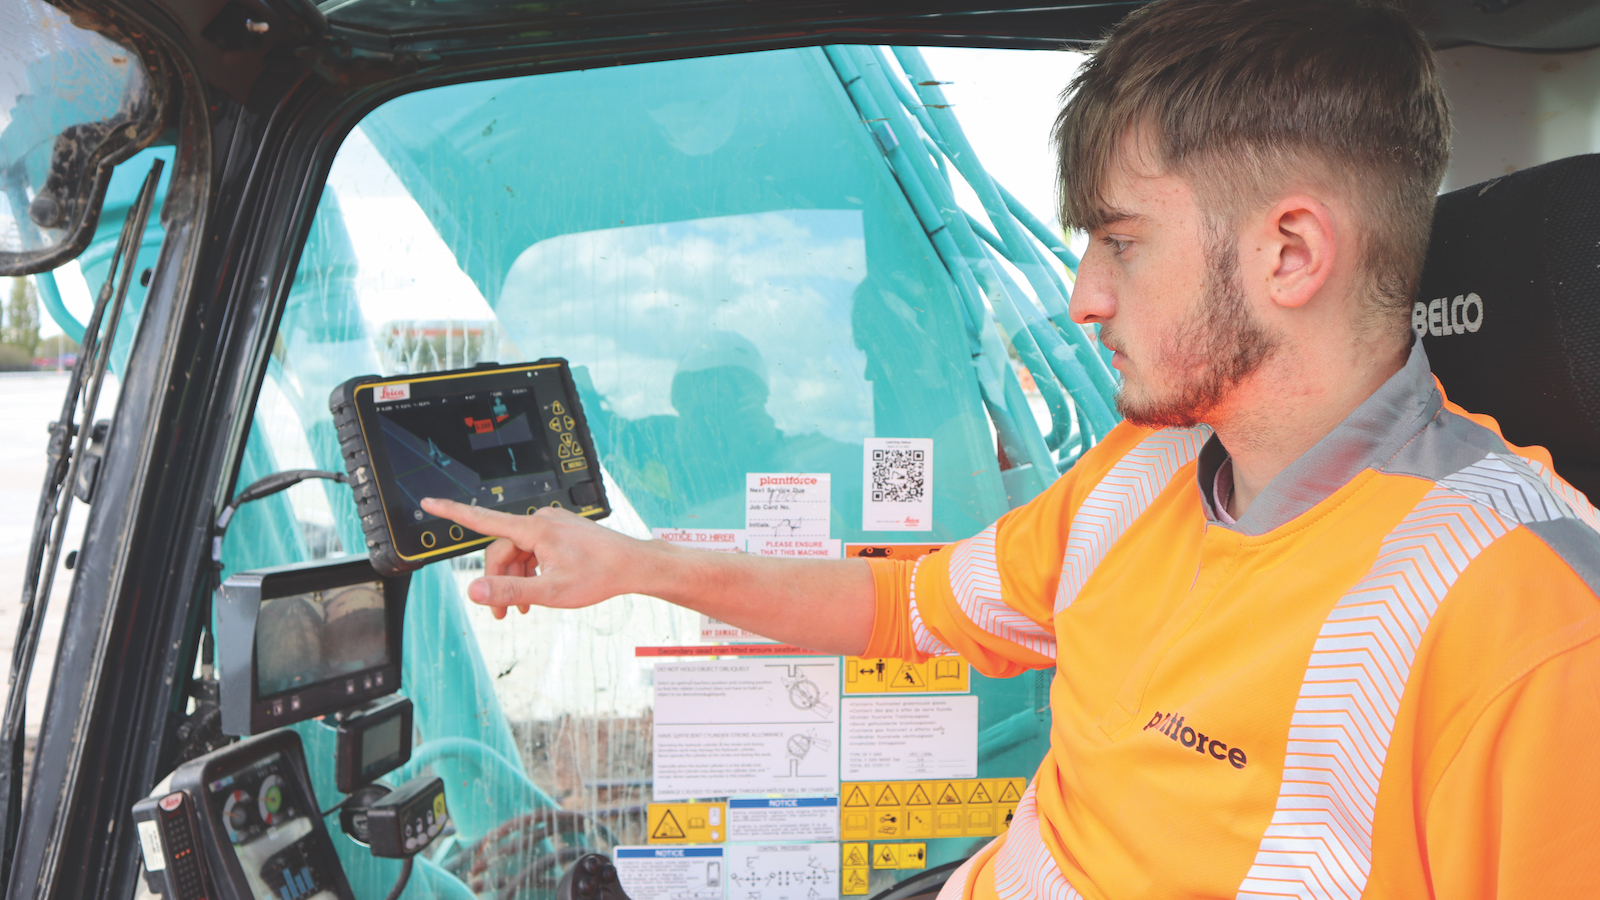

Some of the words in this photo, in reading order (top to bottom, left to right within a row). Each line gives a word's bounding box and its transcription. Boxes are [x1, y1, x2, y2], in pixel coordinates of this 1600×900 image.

[380, 386, 405, 399] Leica
[760, 476, 818, 487] plantforce
[661, 533, 694, 542] NOTICE
[695, 533, 708, 541] TO
[710, 534, 735, 542] HIRER
[702, 629, 714, 637] ANY
[715, 629, 738, 637] DAMAGE
[658, 647, 694, 656] Secondary
[730, 646, 748, 654] fitted
[768, 799, 799, 807] NOTICE
[655, 849, 685, 858] NOTICE
